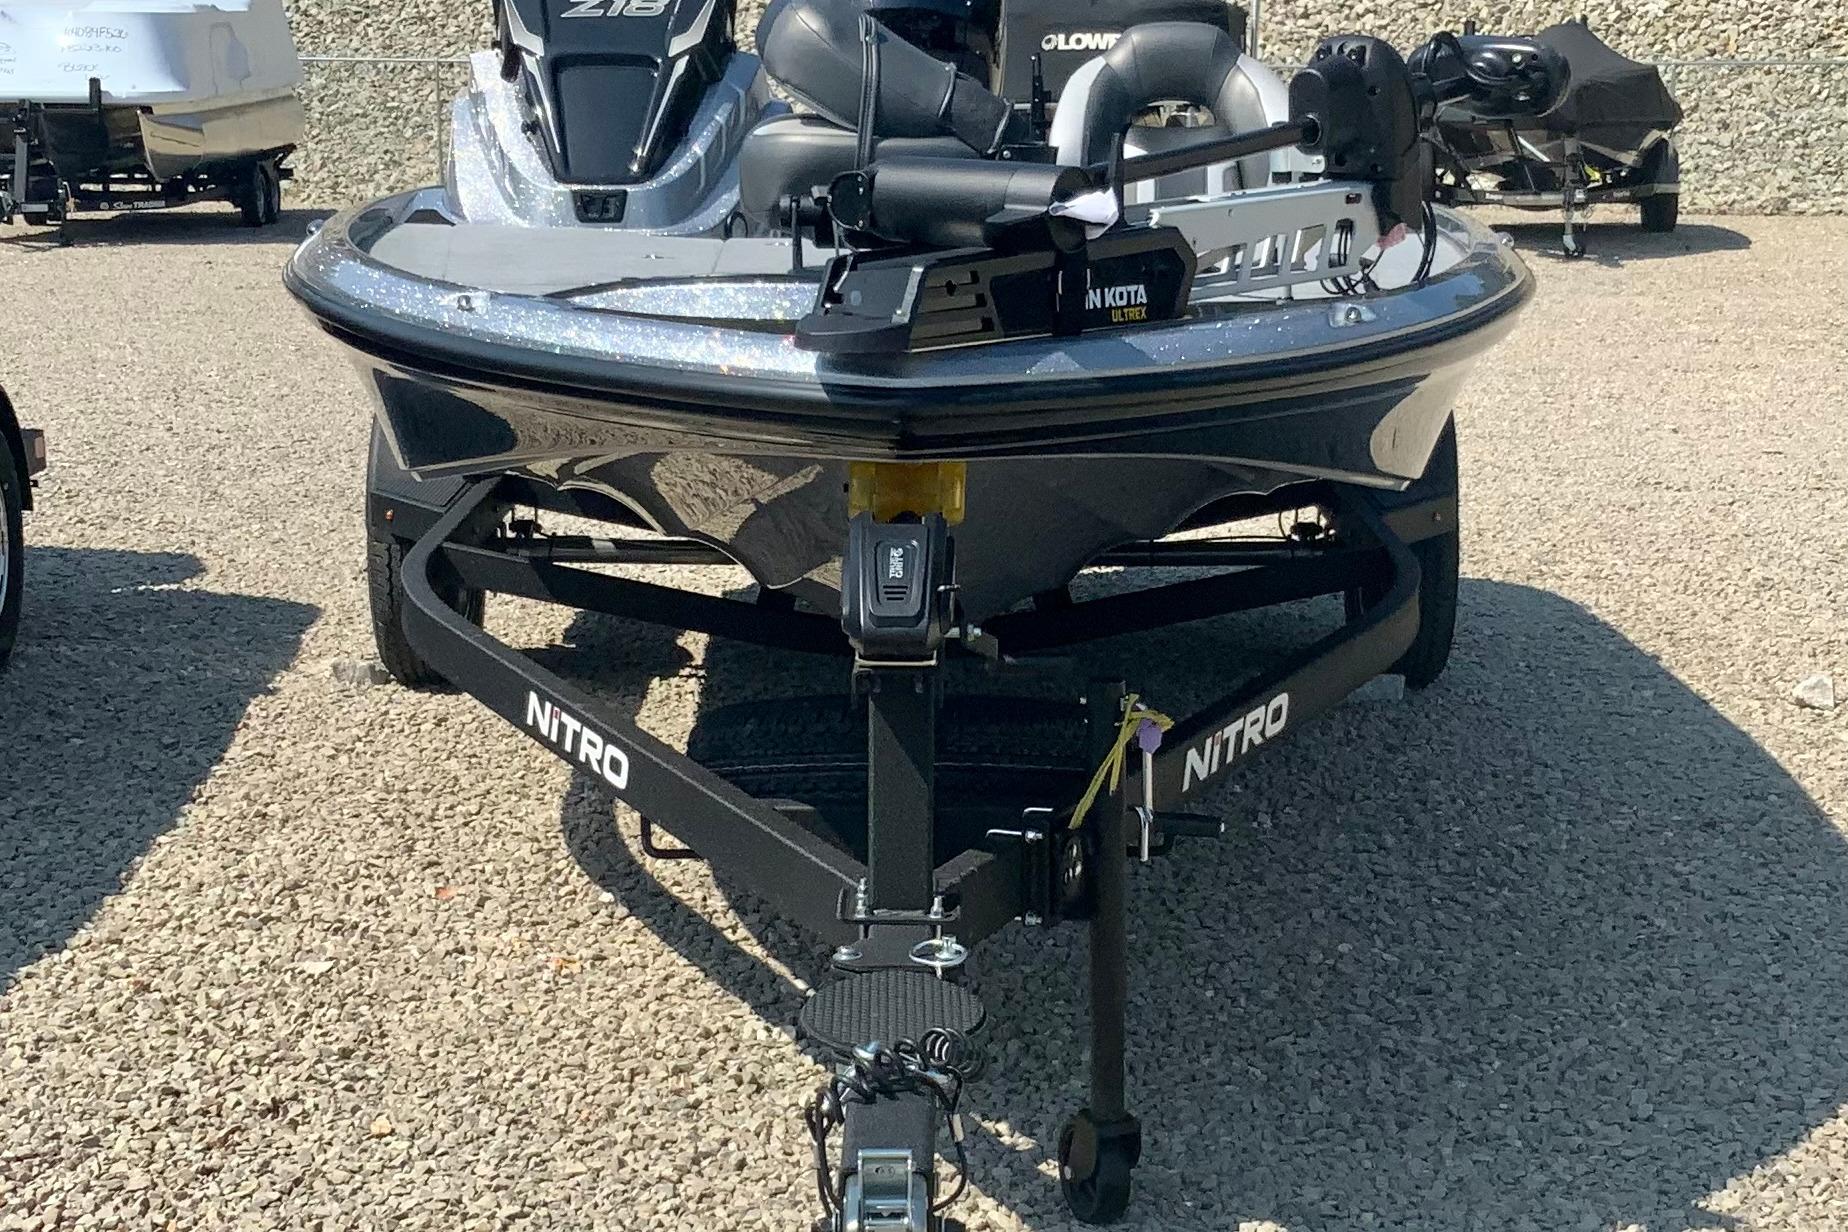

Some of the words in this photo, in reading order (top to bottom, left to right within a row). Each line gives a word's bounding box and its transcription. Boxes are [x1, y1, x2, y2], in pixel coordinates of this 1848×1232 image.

[561, 0, 669, 17] Z18
[1104, 284, 1147, 308] KOTA
[1111, 306, 1147, 322] ULTREX
[527, 690, 629, 790] NITRO
[1182, 692, 1289, 792] NITRO
